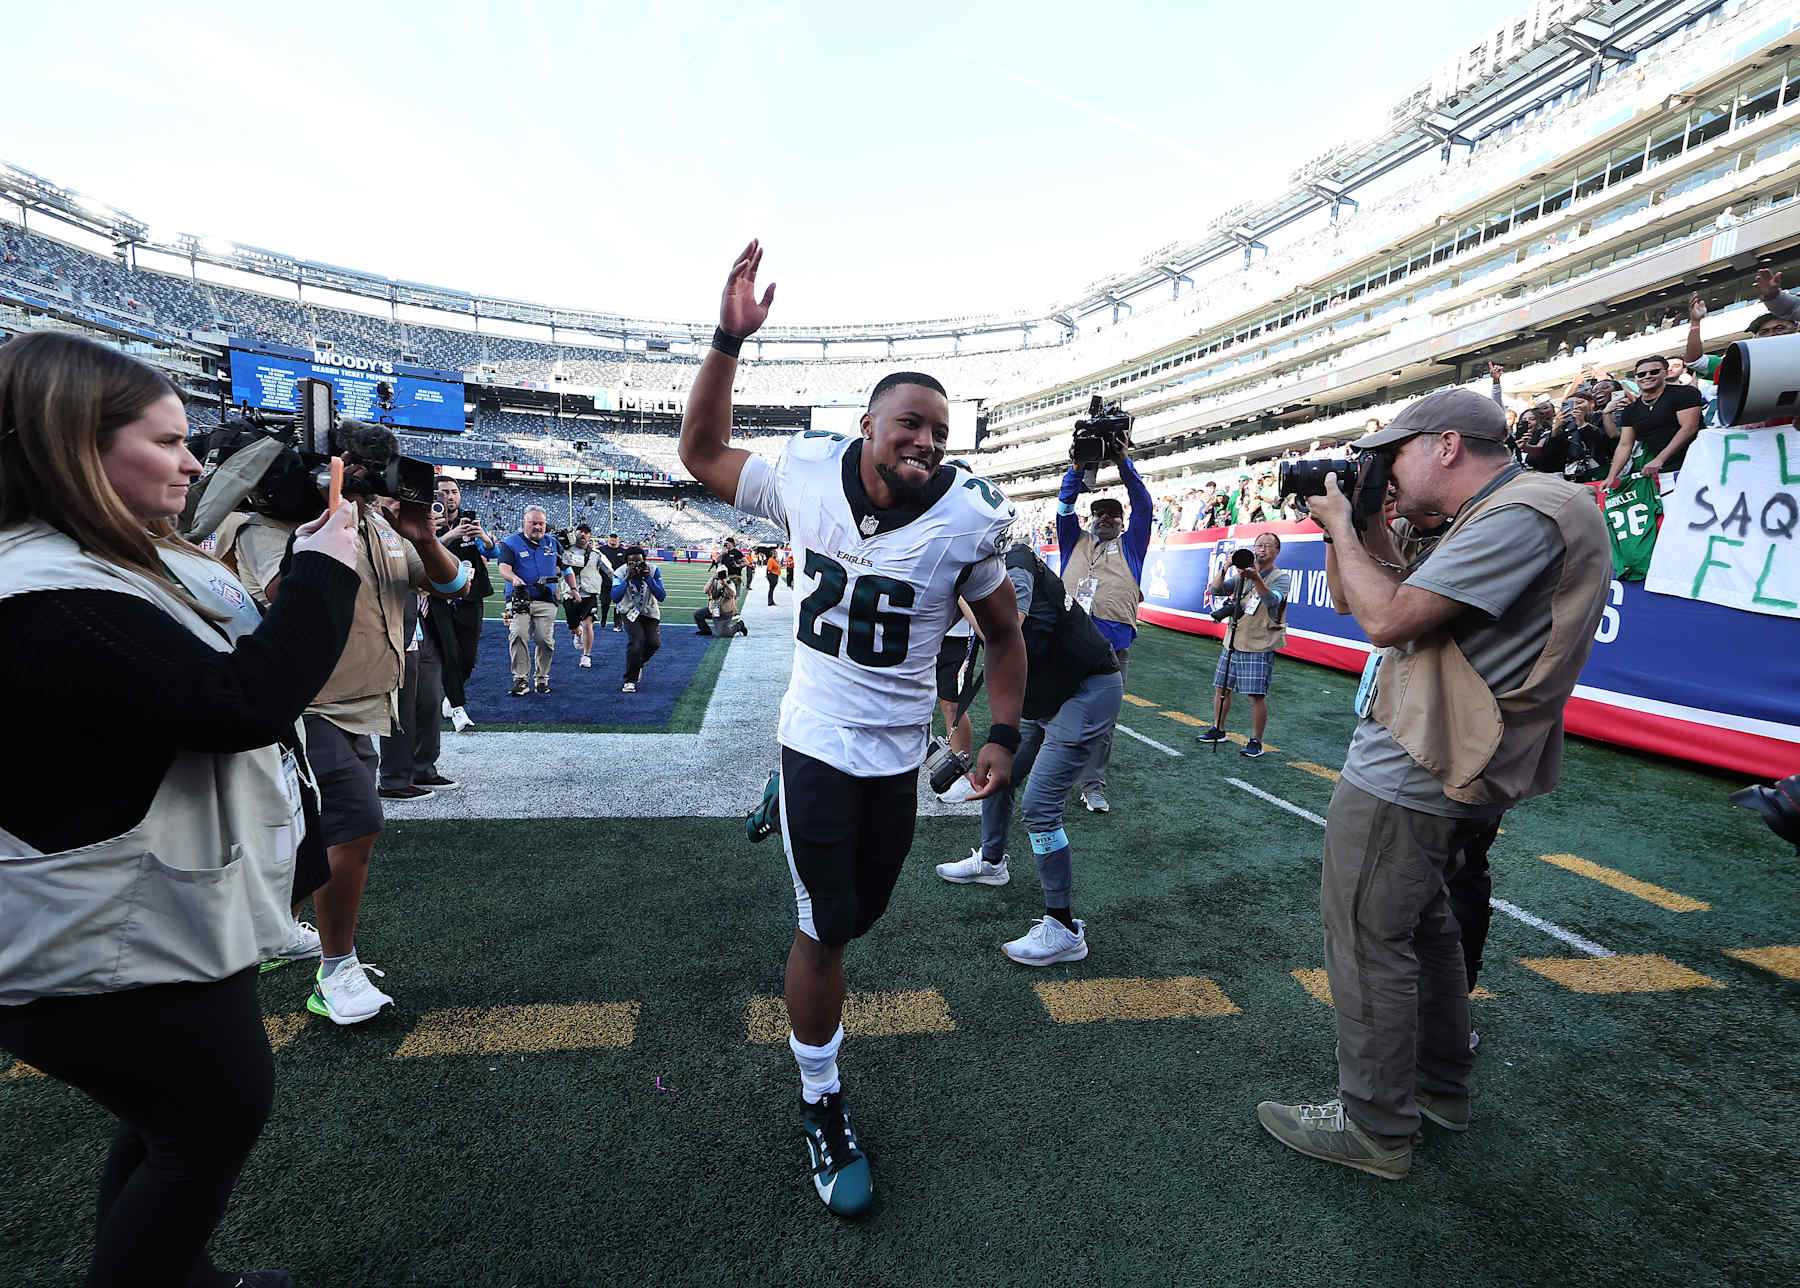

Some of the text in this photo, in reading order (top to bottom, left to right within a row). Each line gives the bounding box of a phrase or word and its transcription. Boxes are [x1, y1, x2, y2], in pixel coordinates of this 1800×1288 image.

[314, 350, 393, 374] MOODY'S
[1608, 502, 1649, 540] 26
[837, 551, 873, 568] EAGLES
[797, 548, 915, 667] 26
